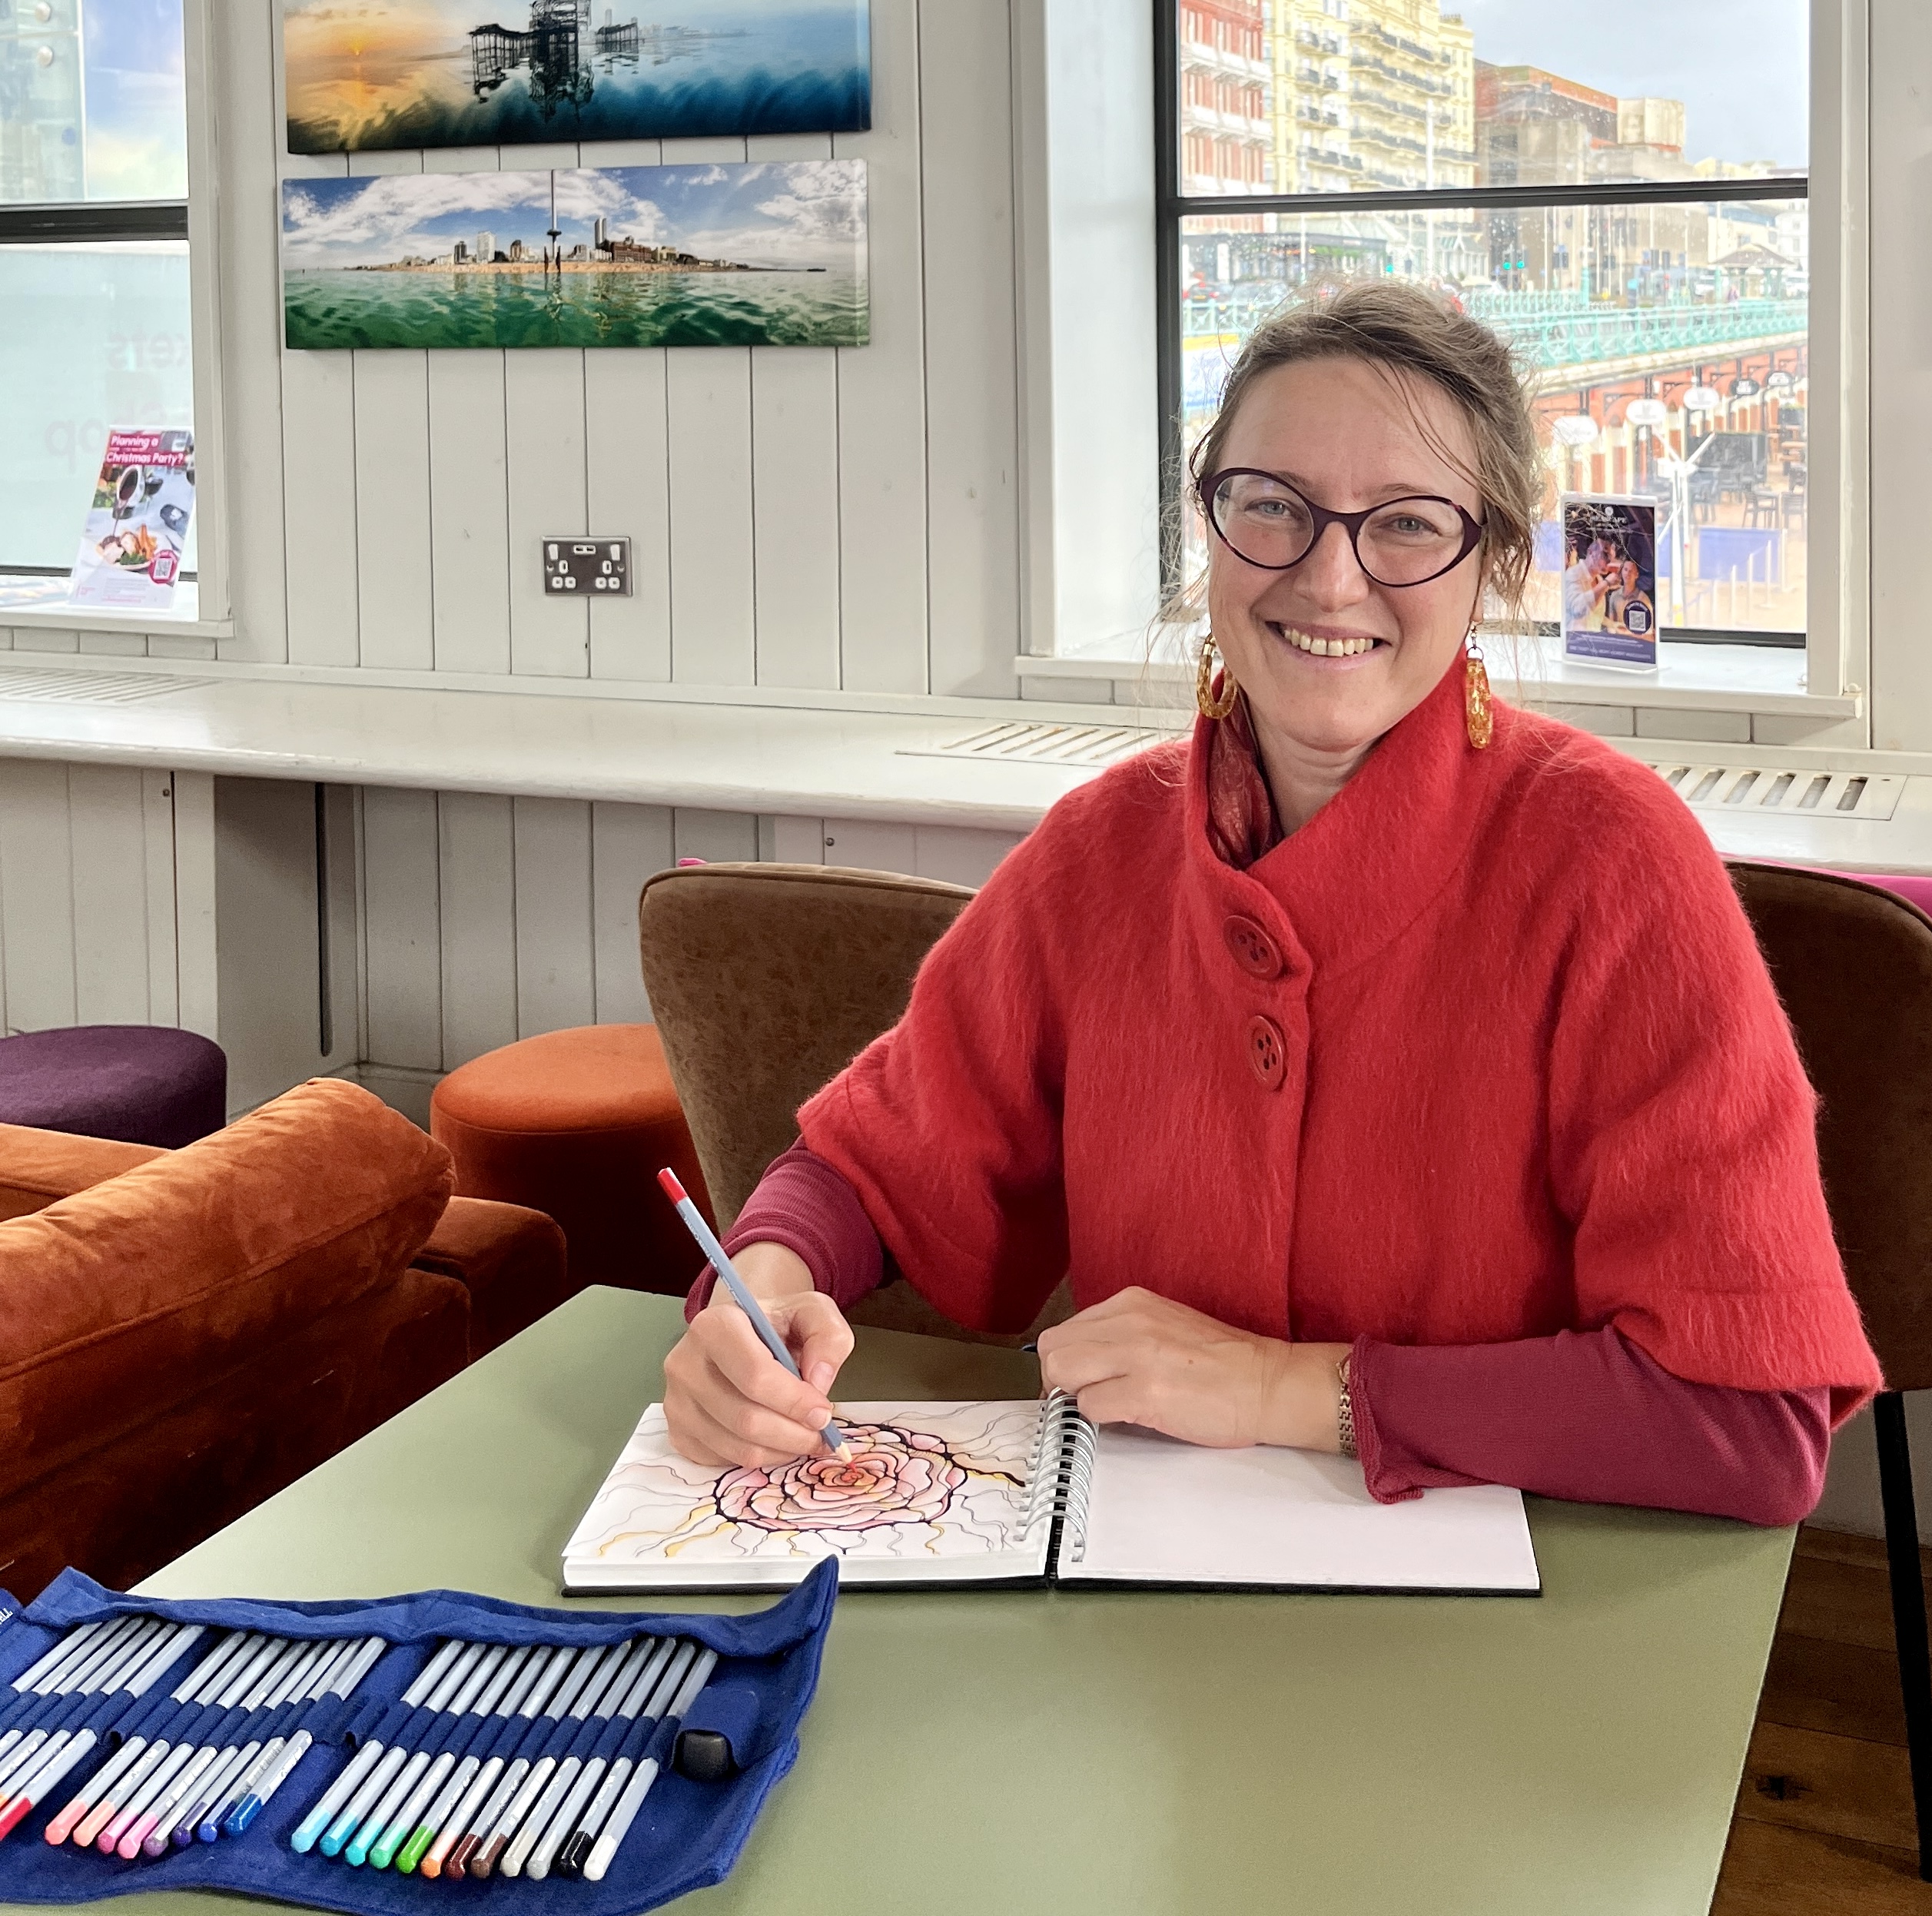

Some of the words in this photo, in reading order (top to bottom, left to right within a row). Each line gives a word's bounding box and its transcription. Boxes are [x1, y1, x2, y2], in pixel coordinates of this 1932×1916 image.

[111, 436, 150, 450] Planning
[151, 437, 158, 447] a
[106, 452, 151, 463] Christmas
[151, 452, 184, 467] Party?
